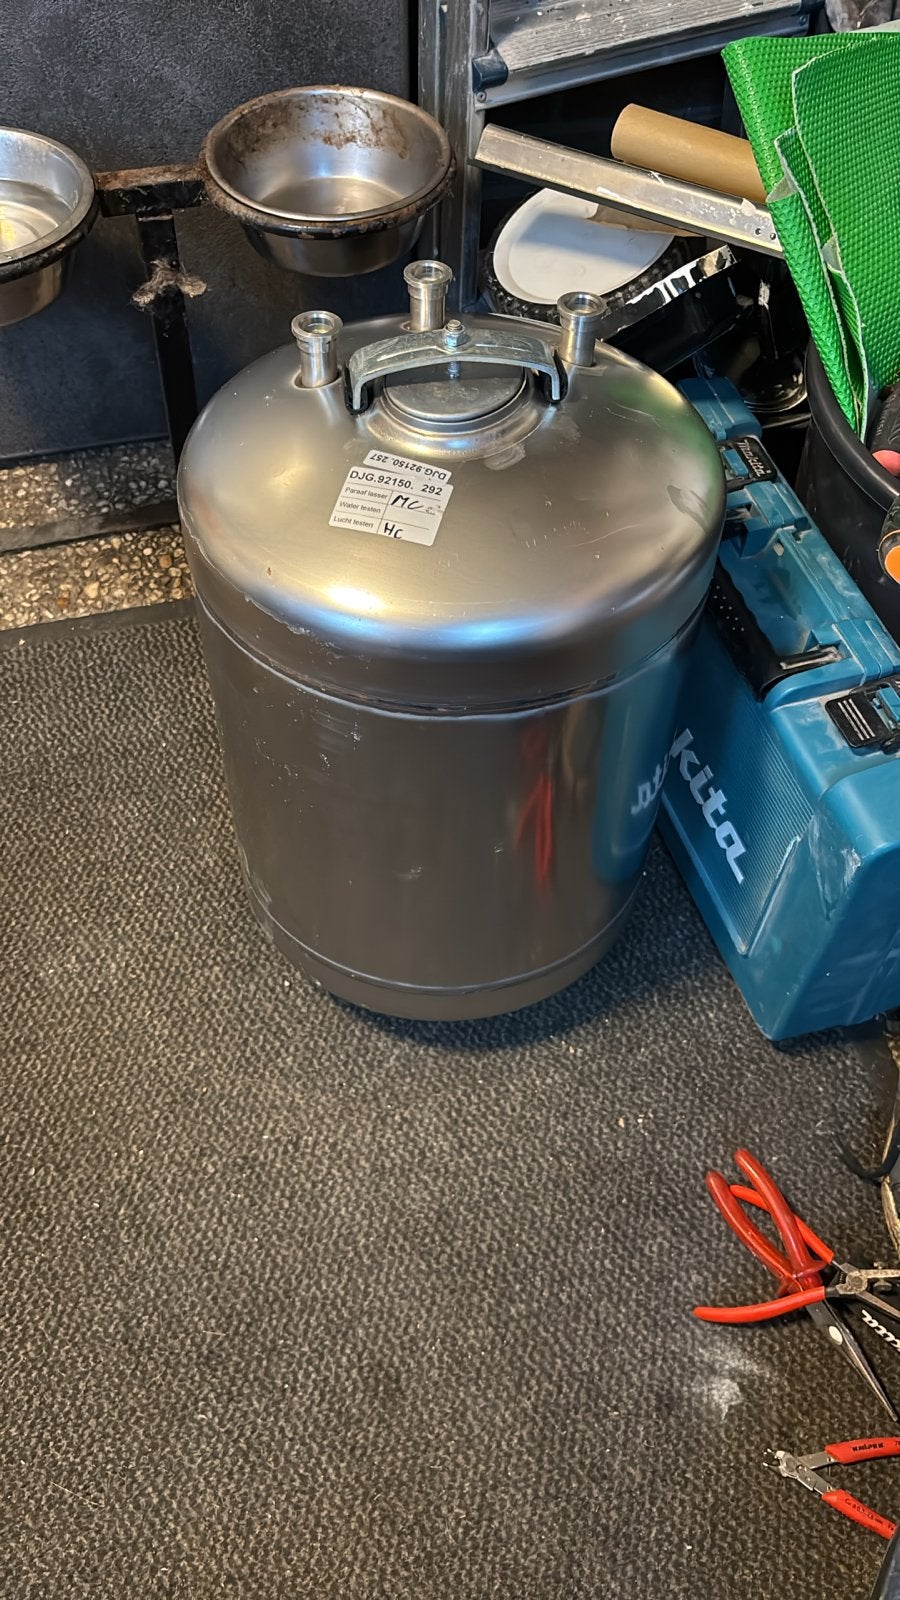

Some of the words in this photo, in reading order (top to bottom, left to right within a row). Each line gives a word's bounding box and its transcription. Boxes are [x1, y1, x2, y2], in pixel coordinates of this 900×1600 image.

[369, 453, 389, 463] 257
[349, 470, 414, 490] DJG.92150.
[420, 484, 443, 496] 292
[344, 486, 367, 496] Paraaf
[367, 490, 389, 500] lasser
[339, 501, 360, 510] Water
[360, 503, 381, 514] testen
[333, 515, 352, 525] Lucht
[352, 518, 374, 529] testen
[669, 728, 746, 885] kita
